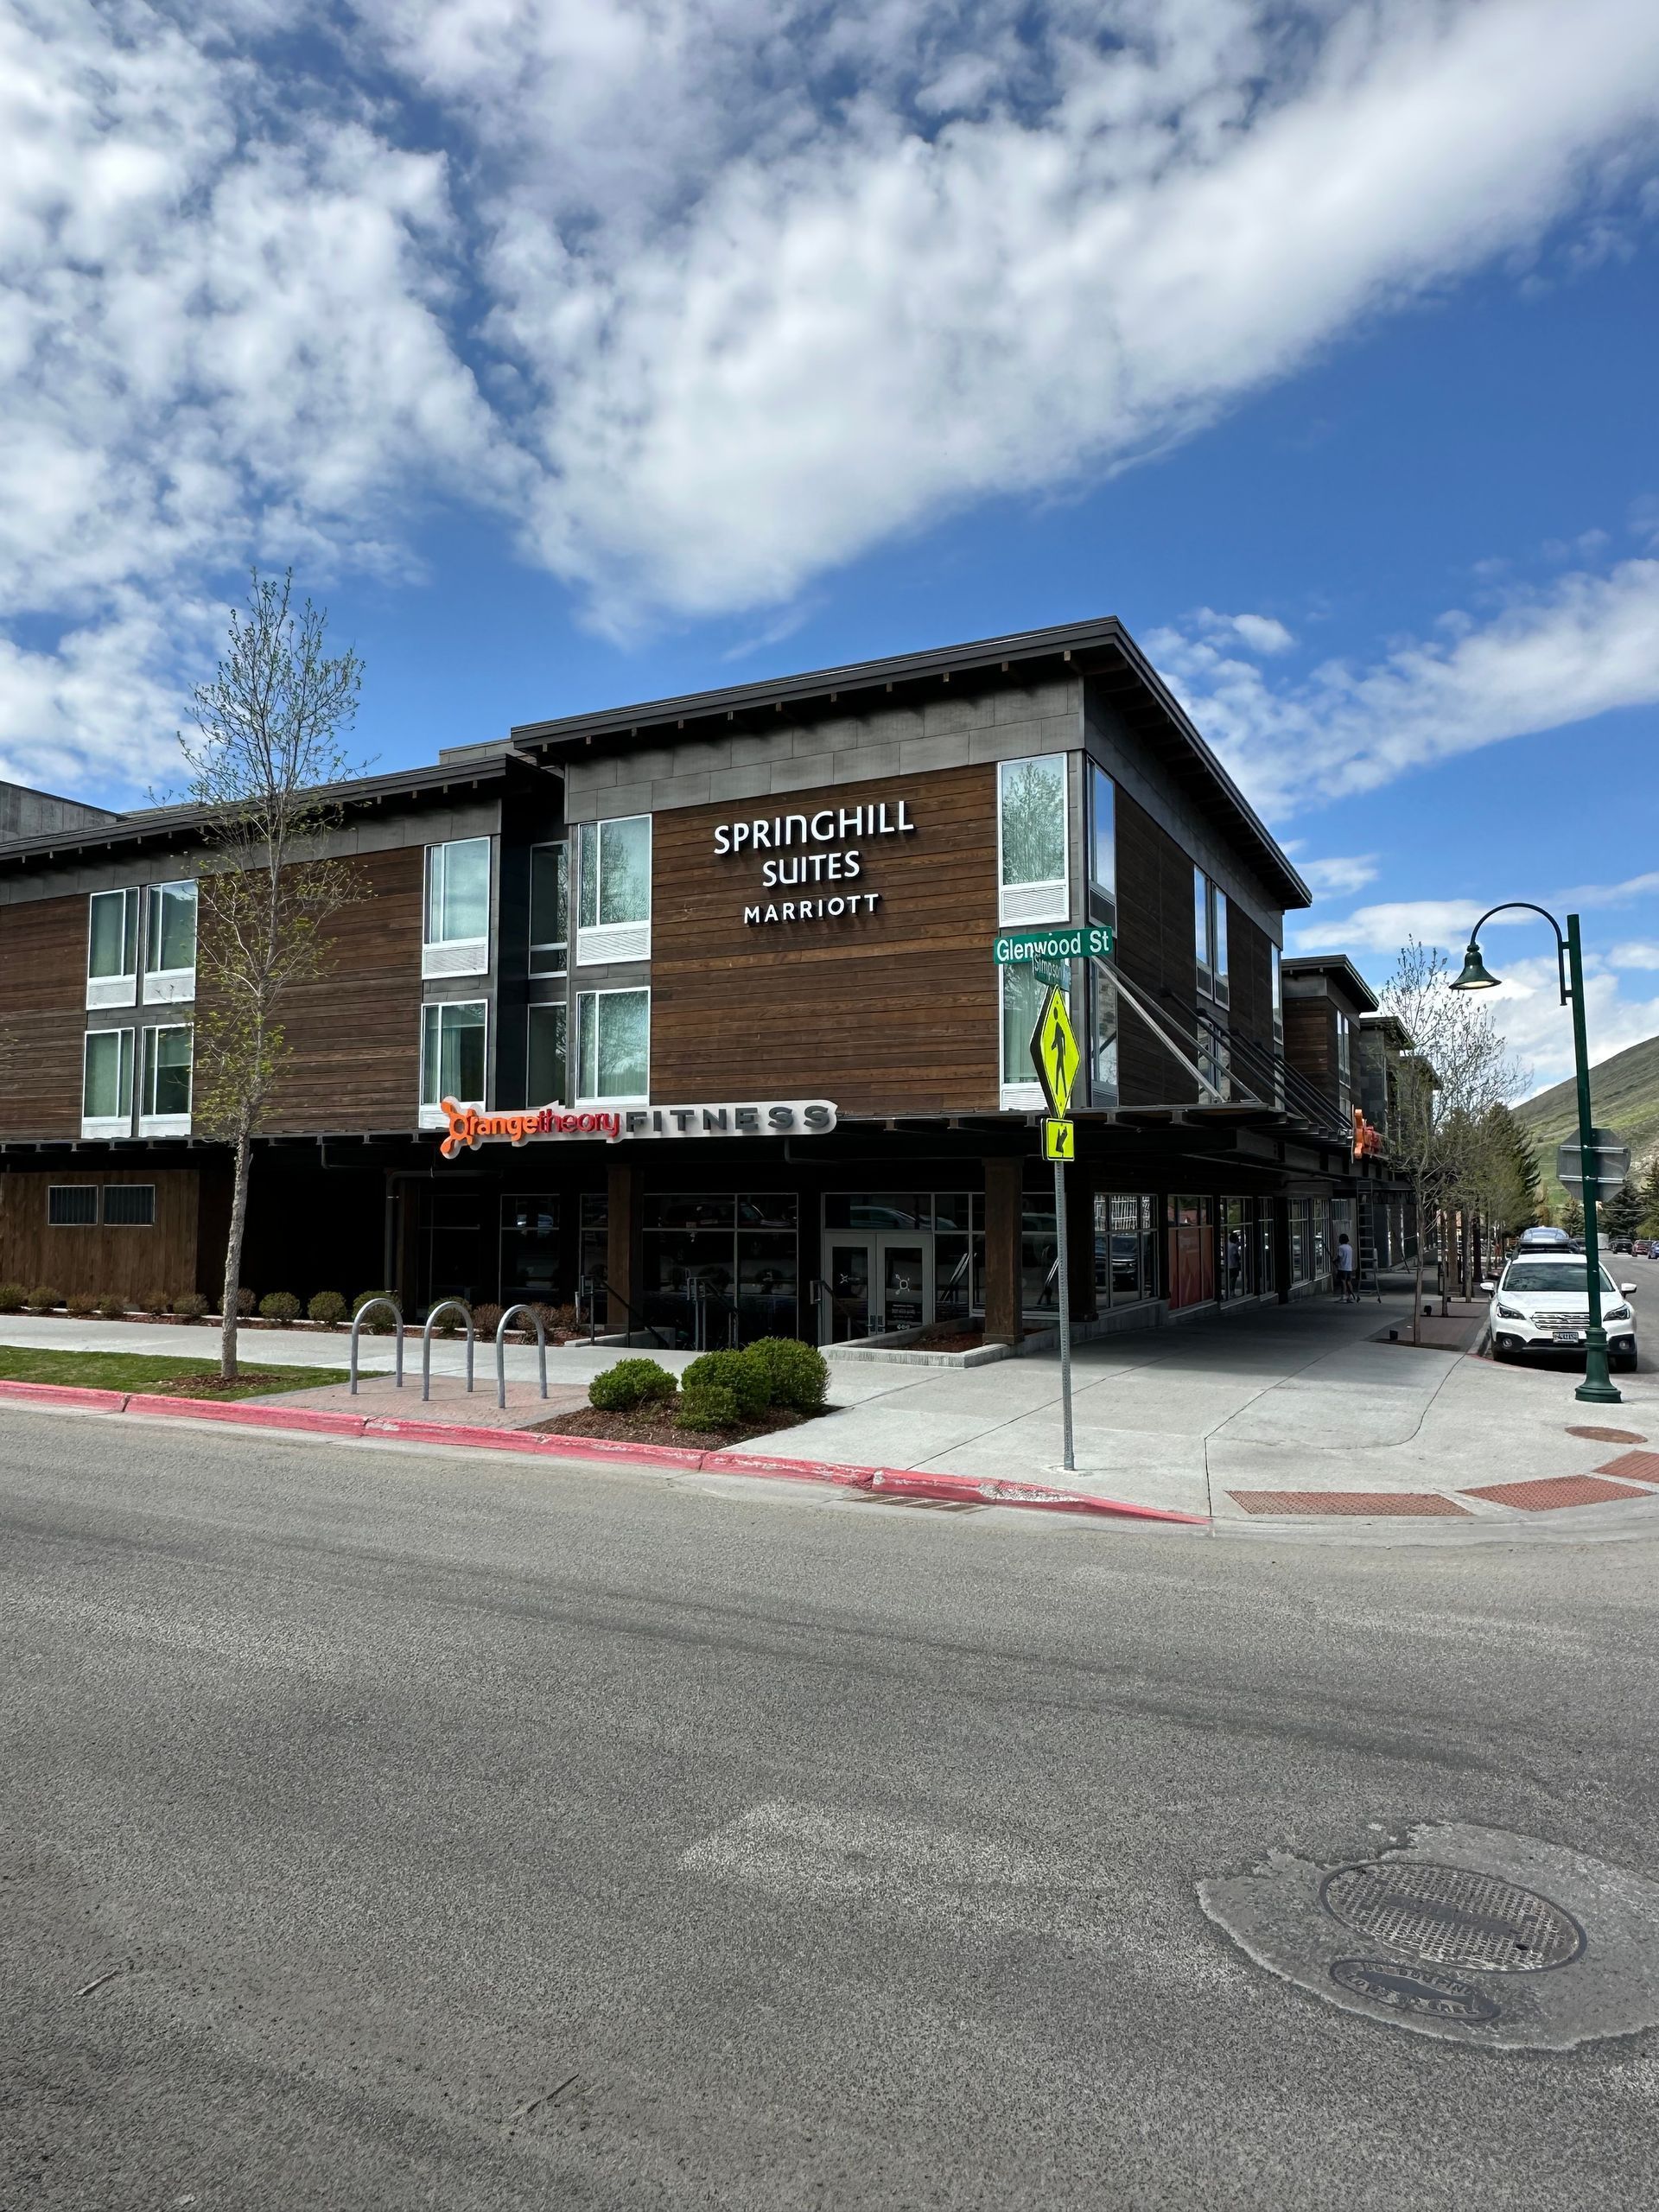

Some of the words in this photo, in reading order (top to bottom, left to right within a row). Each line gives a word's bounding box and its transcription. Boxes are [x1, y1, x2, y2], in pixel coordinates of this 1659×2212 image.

[714, 800, 914, 855] SPRINGHILL
[762, 850, 861, 887] SUITES
[744, 893, 880, 925] MARRIOTT
[996, 932, 1081, 962] Glenwood
[1090, 930, 1109, 953] St
[626, 1105, 830, 1134] FITNESS
